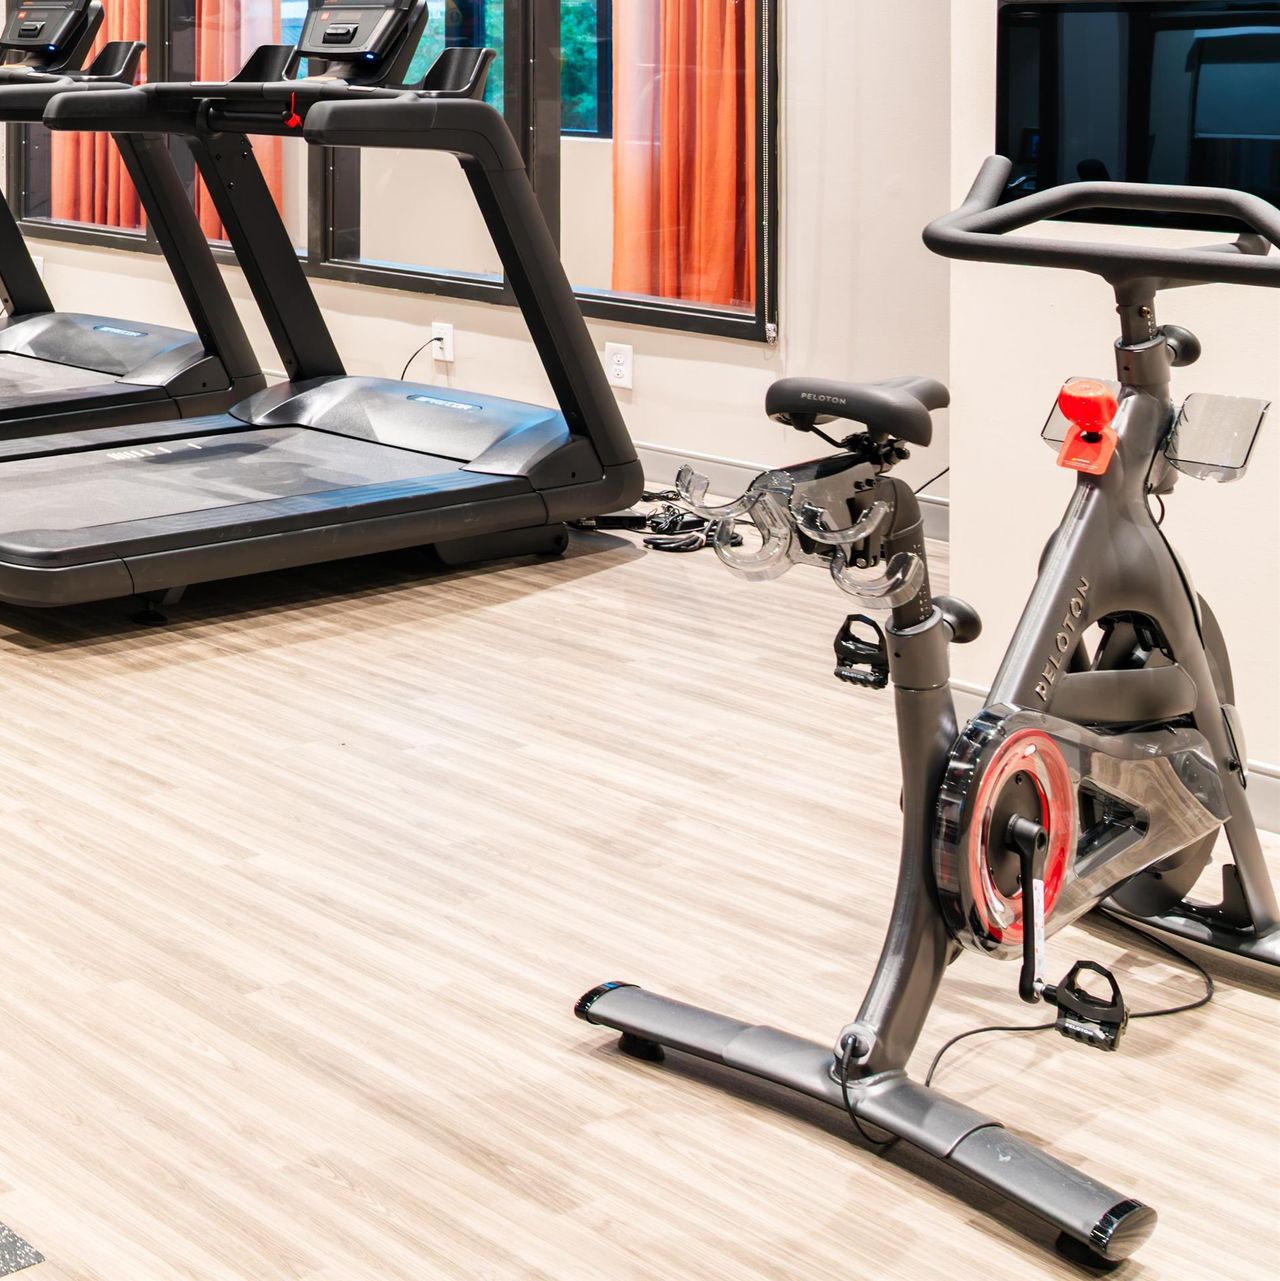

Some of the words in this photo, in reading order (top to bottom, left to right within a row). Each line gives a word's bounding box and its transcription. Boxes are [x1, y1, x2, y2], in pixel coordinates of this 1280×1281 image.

[801, 392, 847, 405] PELOTON
[1034, 576, 1090, 702] PELOTON
[1065, 1022, 1094, 1036] PELOTON
